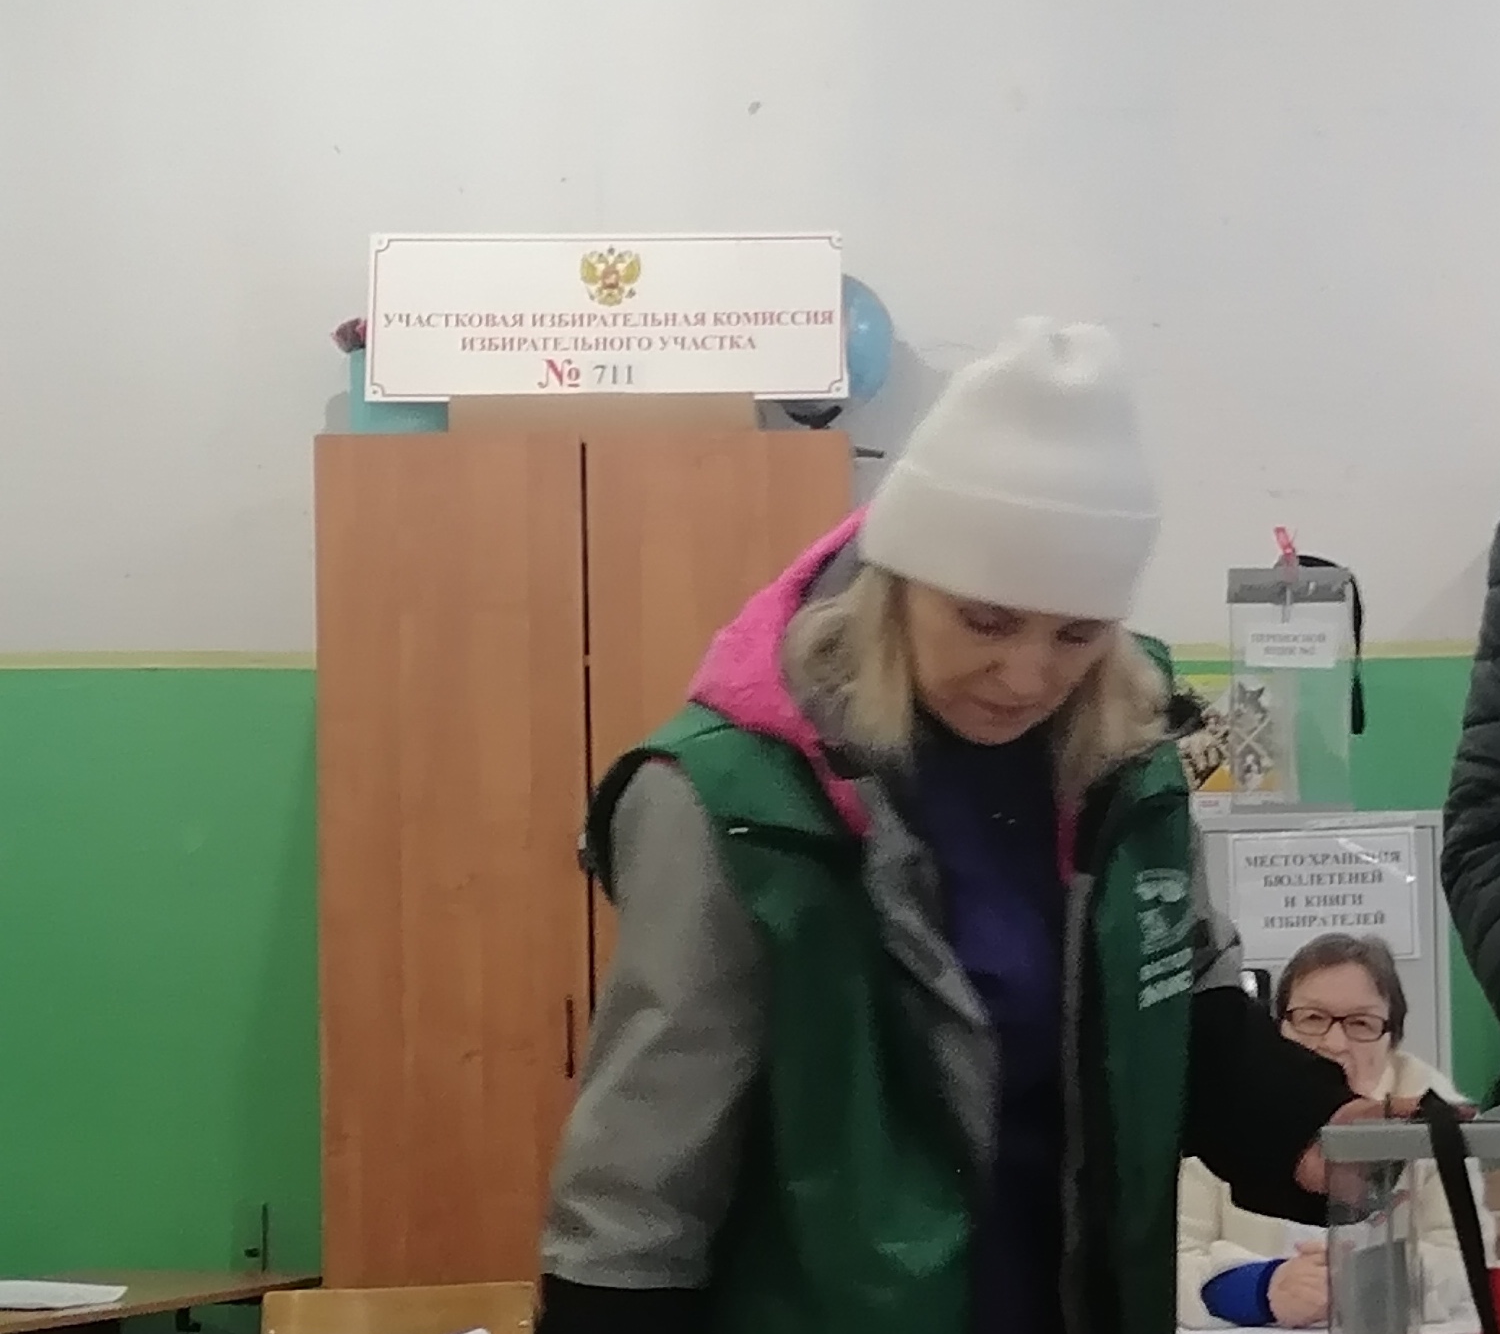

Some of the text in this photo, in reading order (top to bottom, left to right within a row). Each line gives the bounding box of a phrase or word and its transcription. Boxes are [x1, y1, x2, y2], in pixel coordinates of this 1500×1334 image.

[383, 309, 834, 329] УЧАСТКОВАЯ ИЗБИРАТЕЛЬНАЯ КОМИССИЯ
[461, 334, 757, 353] ИЗБИРАТЕЛЬНОГО УЧАСТКА
[593, 363, 635, 385] 711
[1244, 853, 1305, 868] МЕСТО
[1263, 869, 1384, 888] БЮЛЛЕТЕНЕЙ
[1284, 895, 1296, 908] И
[1262, 910, 1386, 930] ИЗБИРАТЕЛЕЙ
